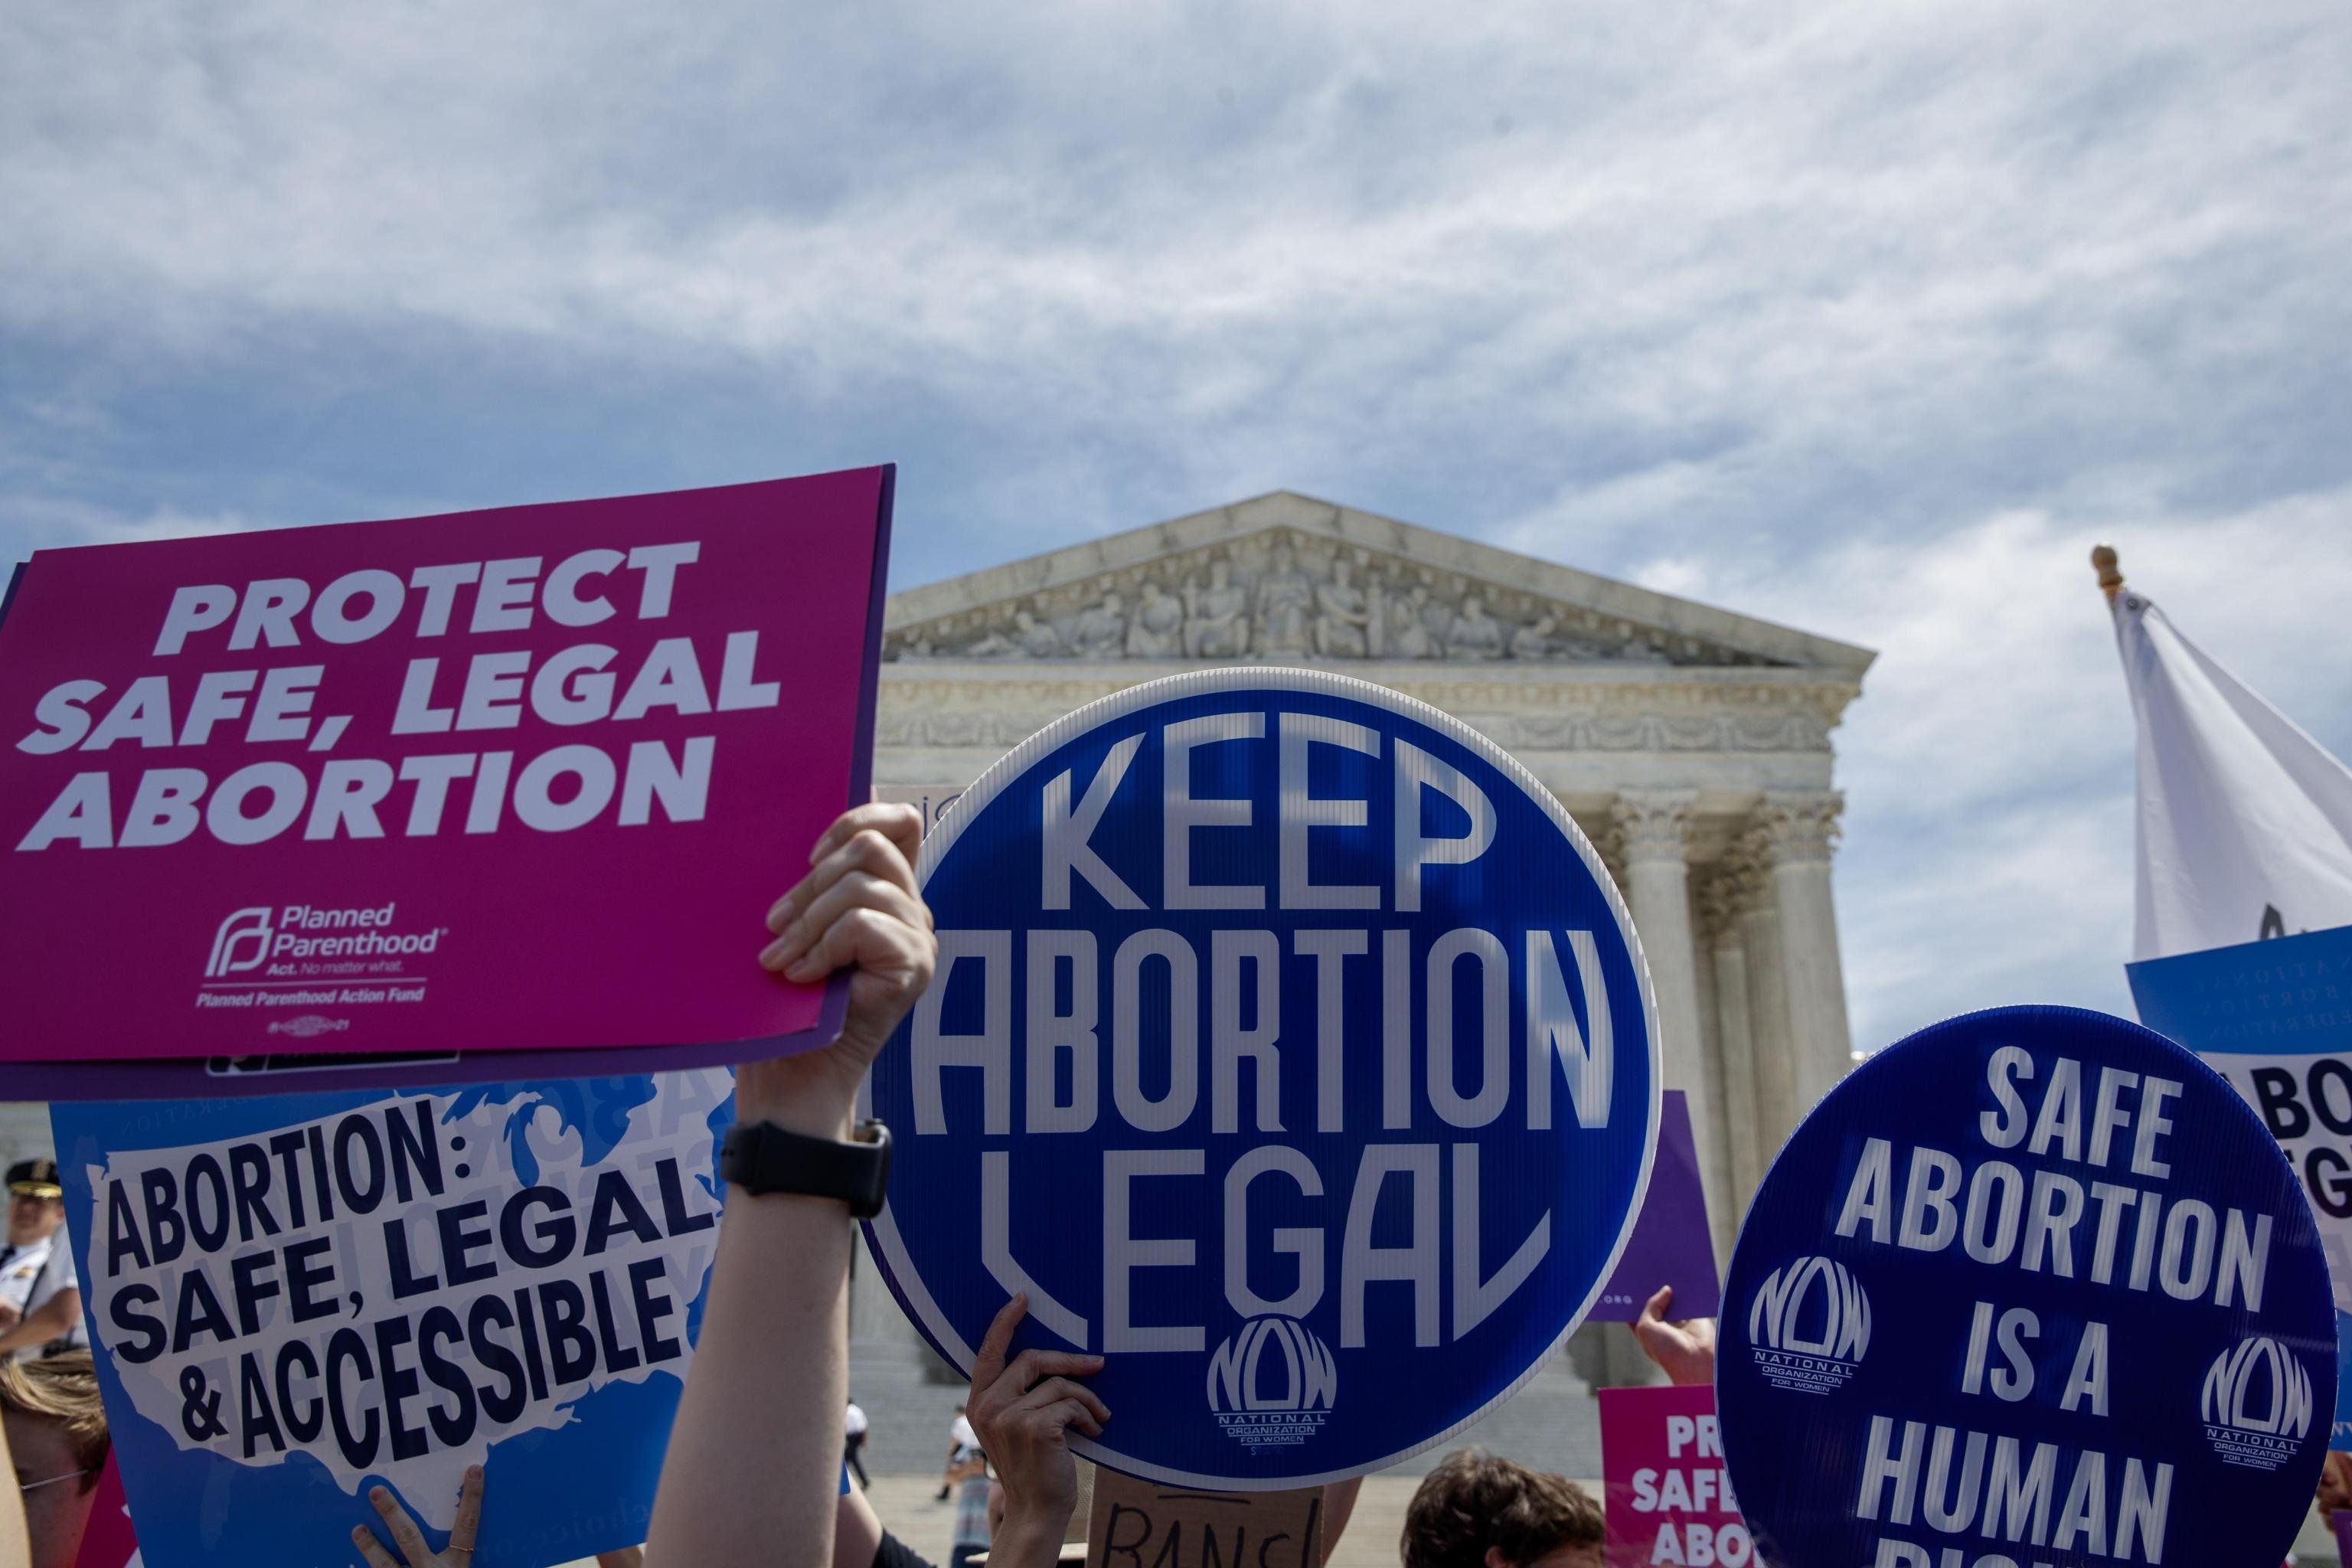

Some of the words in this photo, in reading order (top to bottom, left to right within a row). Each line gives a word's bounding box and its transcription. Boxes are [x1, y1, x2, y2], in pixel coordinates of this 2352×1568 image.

[152, 541, 701, 656] PROTECT
[15, 665, 354, 755] SAFE,
[390, 629, 781, 735] LEGAL
[15, 736, 716, 851] ABORTION
[1041, 710, 1498, 913] KEEP
[280, 902, 395, 929] Planned
[196, 991, 253, 1008] Planned
[255, 990, 336, 1006] Parenthood
[338, 988, 384, 1004] Action
[387, 986, 425, 1002] Fund
[266, 963, 297, 976] Act.
[321, 962, 367, 974] matter
[910, 928, 1614, 1135] ABORTION
[1980, 1045, 2184, 1180] SAFE
[107, 1099, 472, 1277] ABORTION:
[1834, 1136, 2273, 1313] ABORTION
[109, 1240, 364, 1365] SAFE,
[383, 1156, 715, 1299] LEGAL
[981, 1142, 1551, 1354] LEGAL
[1749, 1256, 1872, 1362] NOW
[1962, 1301, 2041, 1403] IS
[2060, 1321, 2110, 1417] A
[1207, 1318, 1338, 1412] NOW
[1754, 1351, 1854, 1376] NATIONAL
[1762, 1365, 1843, 1385] ORGANIZATION
[1772, 1378, 1792, 1387] FOR
[1794, 1381, 1830, 1393] WOMEN
[2201, 1337, 2313, 1439] NOW
[1218, 1414, 1326, 1425] NATIONAL
[1227, 1425, 1316, 1436] ORGANIZATION
[2207, 1428, 2298, 1452] NATIONAL
[2213, 1442, 2288, 1461] ORGANIZATION
[2223, 1454, 2242, 1462] FOR
[2243, 1458, 2277, 1468] WOMEN
[1856, 1415, 2174, 1565] HUMAN
